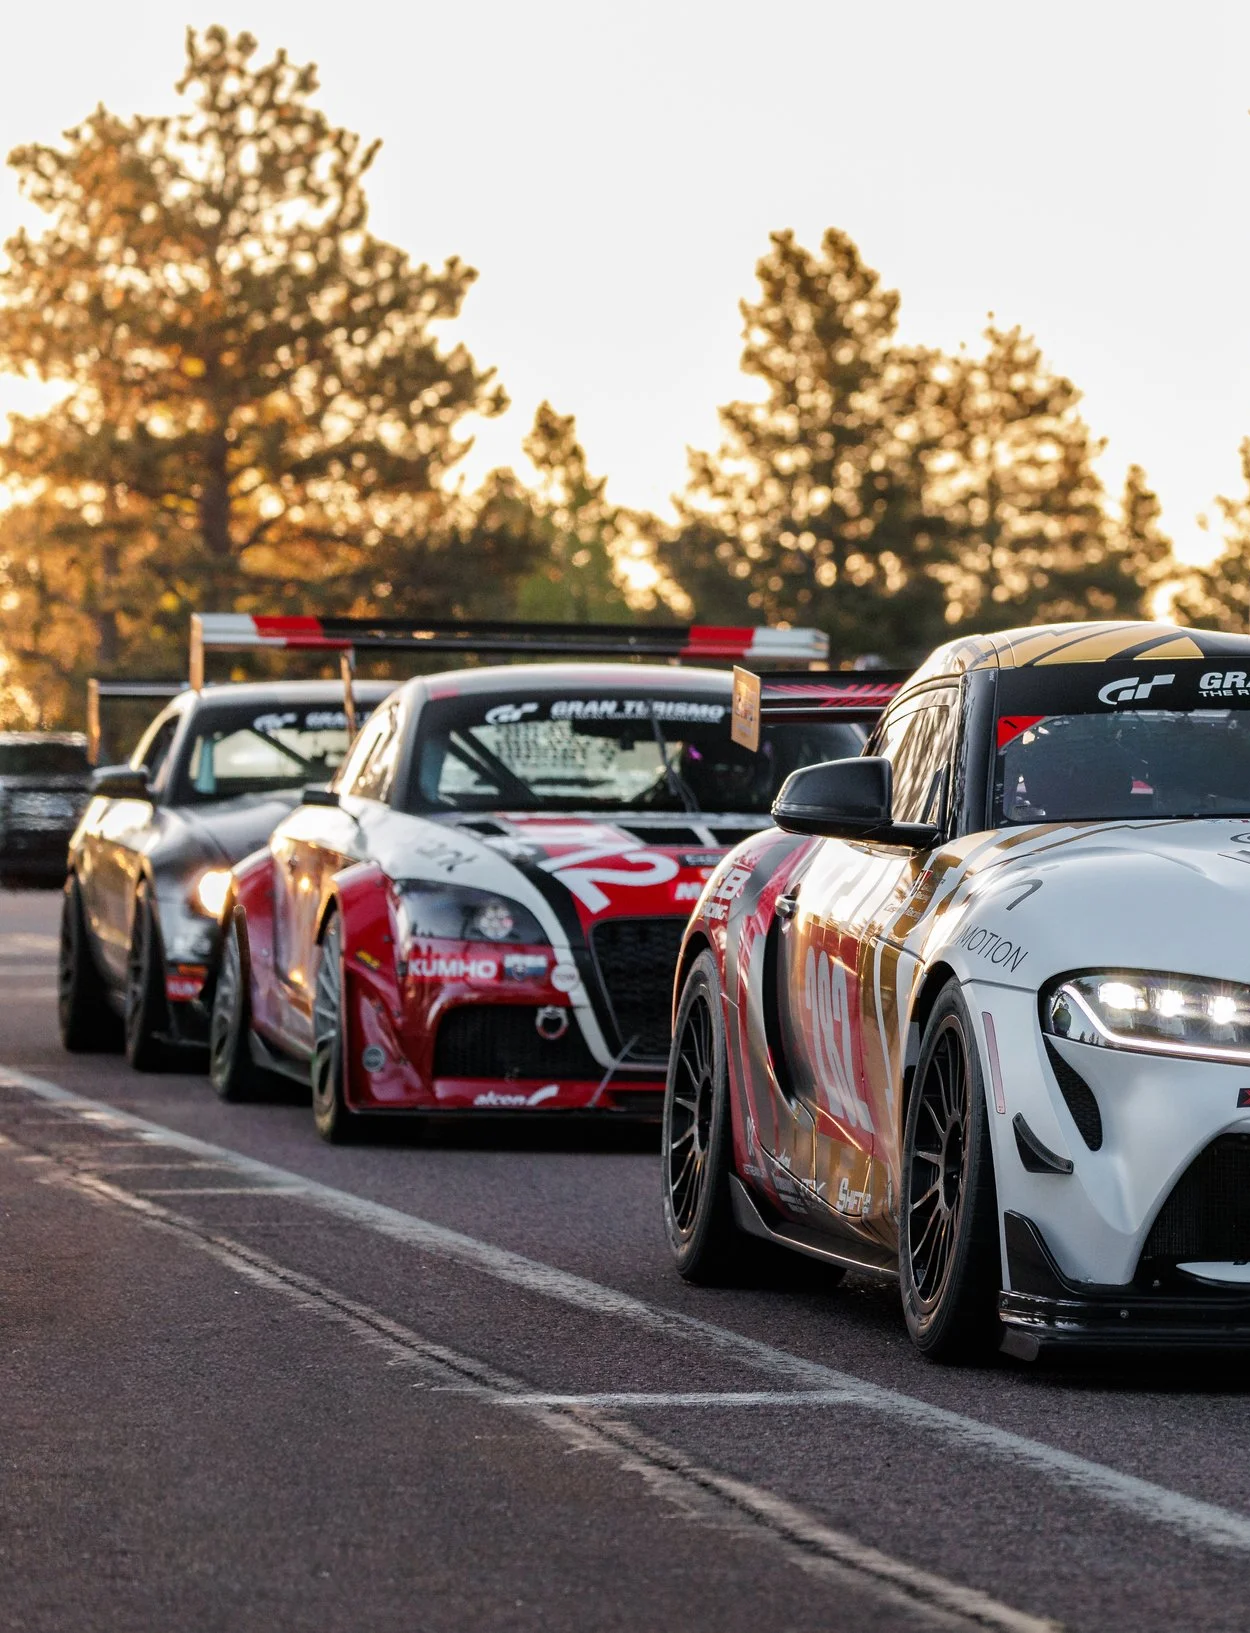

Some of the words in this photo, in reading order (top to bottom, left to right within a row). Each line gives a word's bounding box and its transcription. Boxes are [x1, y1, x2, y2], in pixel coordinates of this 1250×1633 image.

[551, 700, 617, 716] GRAN
[955, 924, 1029, 973] MOTION
[408, 959, 498, 979] KUMHO
